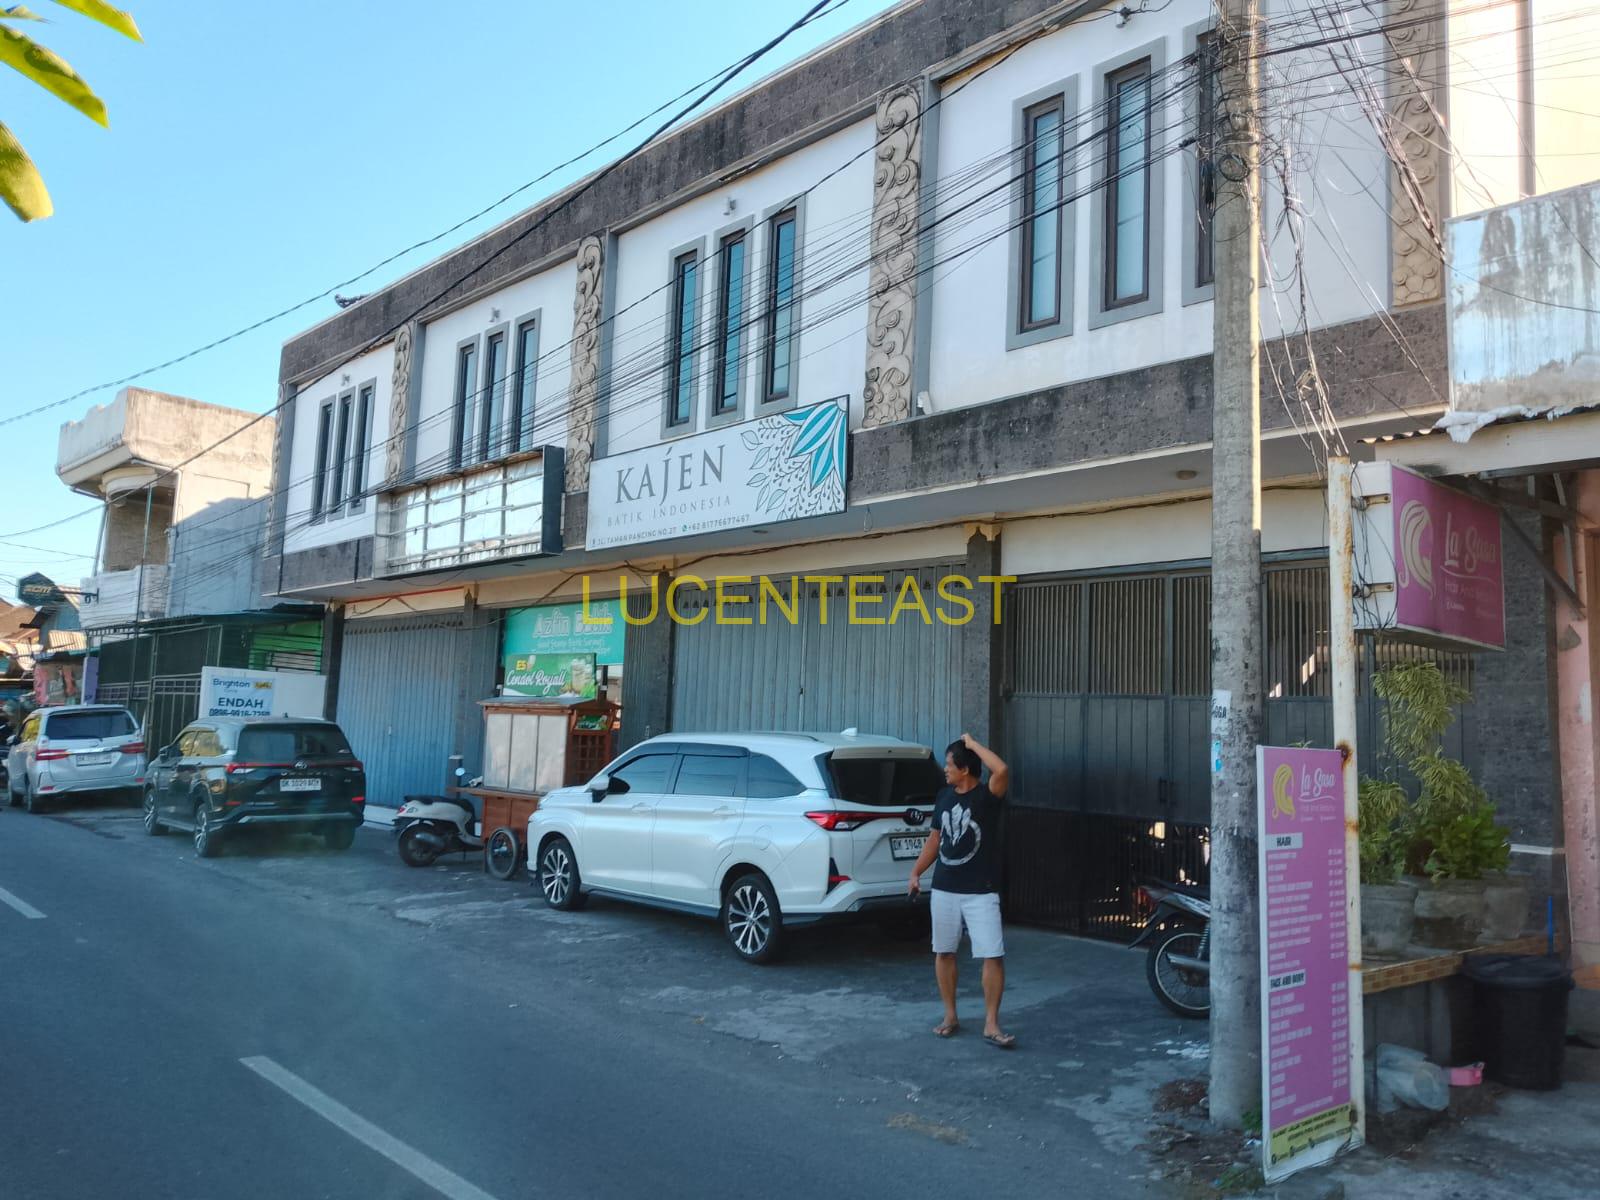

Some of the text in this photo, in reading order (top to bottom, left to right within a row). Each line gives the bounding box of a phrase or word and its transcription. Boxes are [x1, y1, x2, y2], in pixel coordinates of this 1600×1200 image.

[607, 495, 731, 528] BATIK INDONESIA
[213, 678, 250, 688] Brighton
[218, 697, 264, 708] ENDAH
